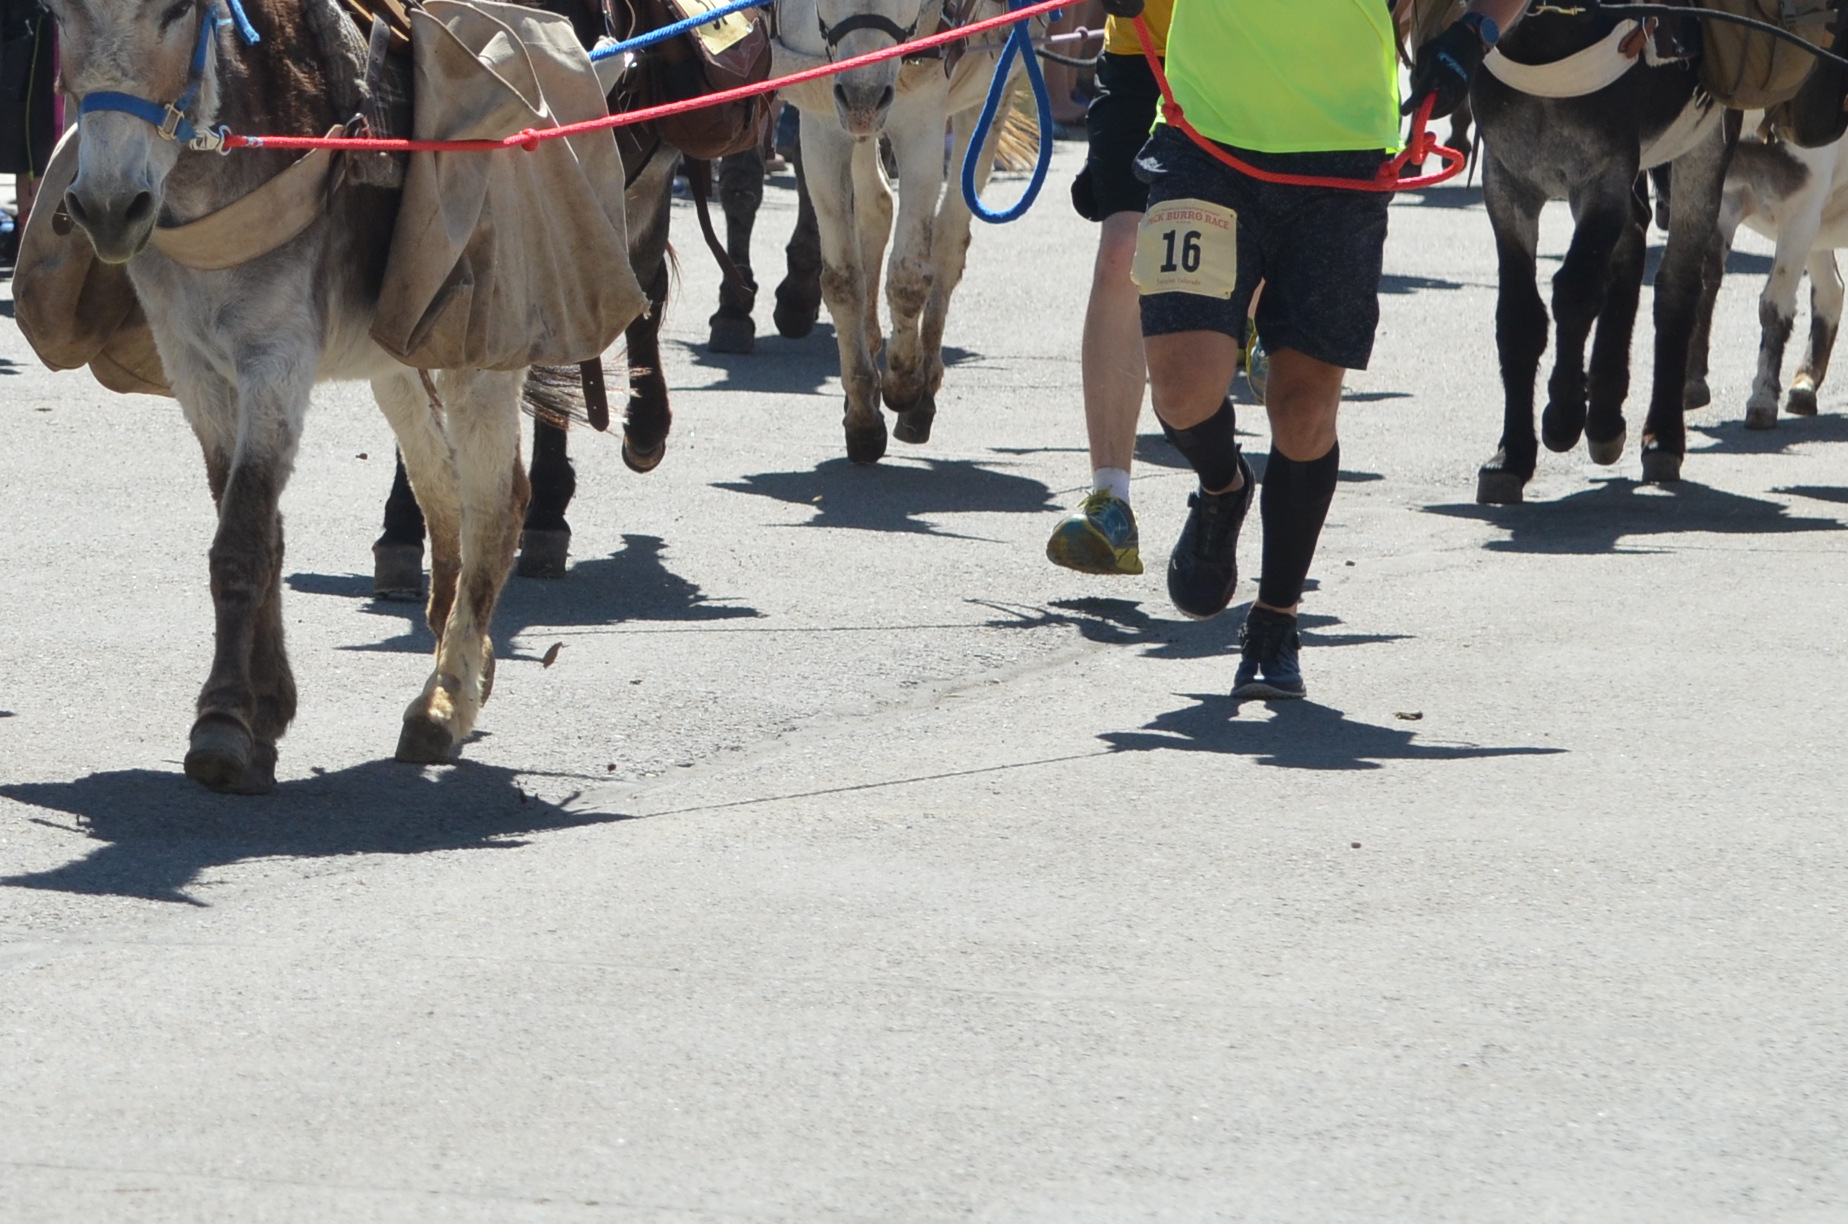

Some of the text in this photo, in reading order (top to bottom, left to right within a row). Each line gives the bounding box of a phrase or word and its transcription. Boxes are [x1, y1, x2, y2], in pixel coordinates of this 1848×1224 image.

[1166, 210, 1203, 221] BURRO
[1205, 214, 1229, 229] RACE
[1160, 229, 1202, 273] 16
